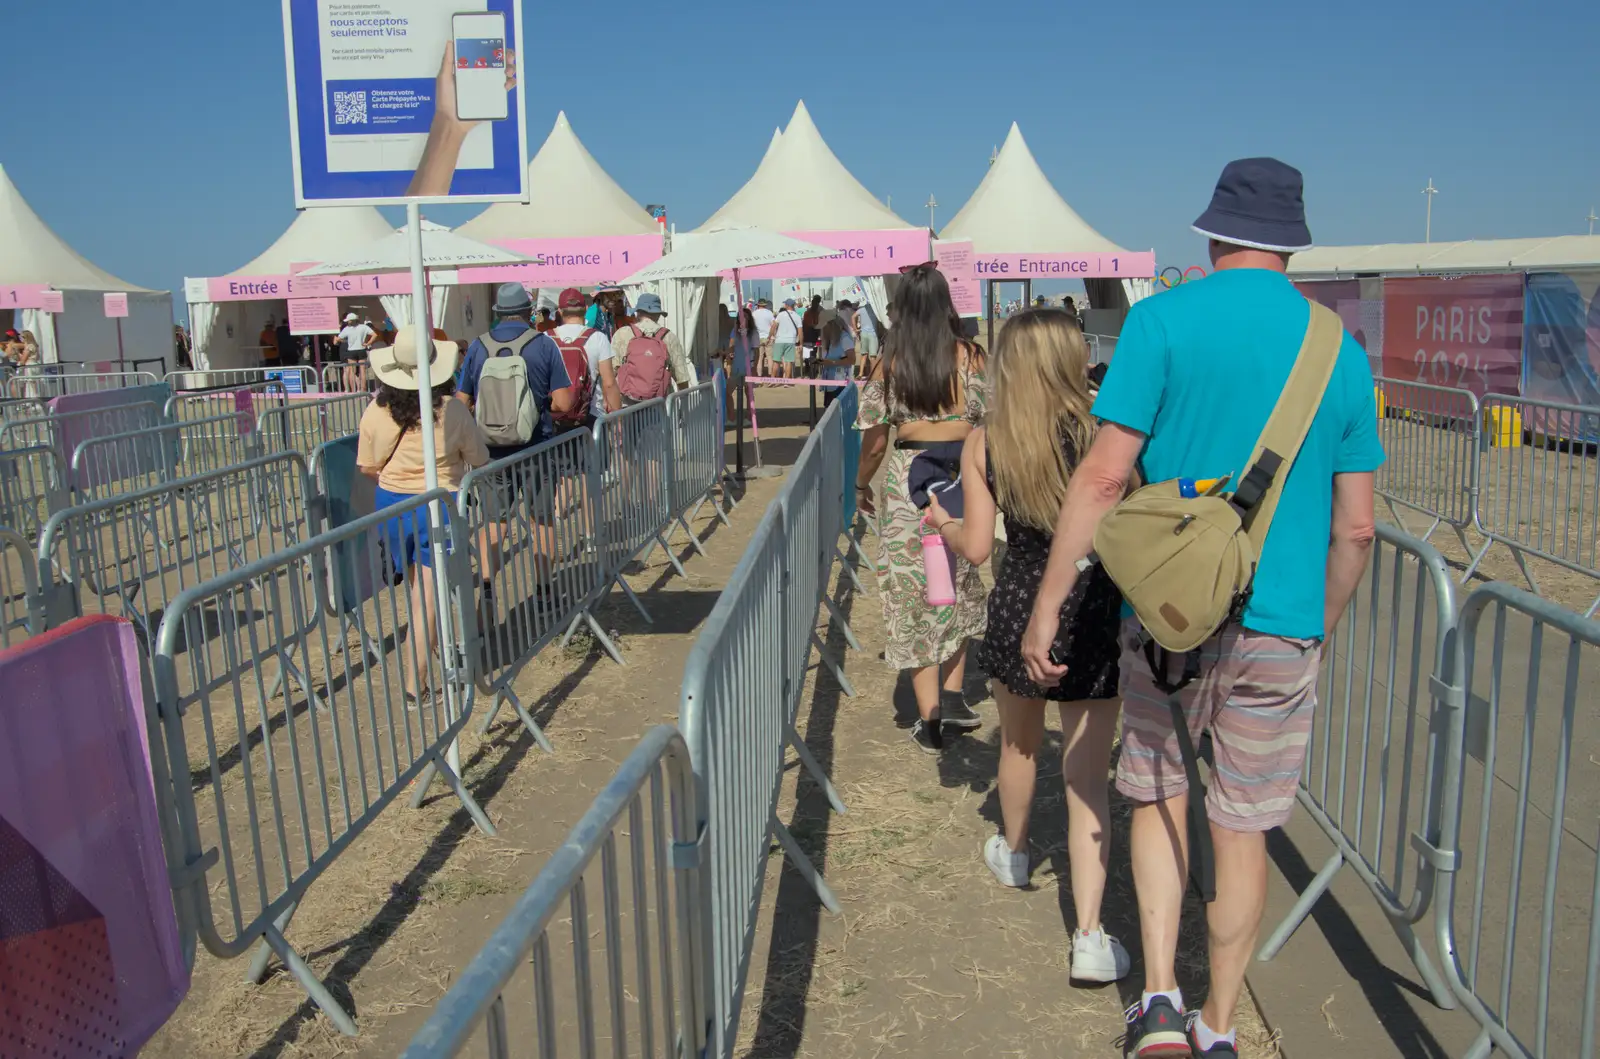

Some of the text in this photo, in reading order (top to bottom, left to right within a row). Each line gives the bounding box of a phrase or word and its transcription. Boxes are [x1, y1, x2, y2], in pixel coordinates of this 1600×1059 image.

[330, 17, 408, 27] nous acceptons
[330, 27, 406, 37] seulement Visa
[537, 253, 600, 266] Entrance
[622, 251, 629, 263] 1
[736, 253, 775, 263] PARIS
[886, 246, 894, 258] 1
[974, 259, 1008, 273] trée
[1019, 259, 1088, 272] Entrance
[1111, 258, 1119, 271] 1
[230, 280, 278, 295] Entrée
[373, 276, 380, 289] 1
[10, 291, 17, 303] 1
[1416, 305, 1492, 344] PARIS
[1414, 348, 1488, 391] 2024
